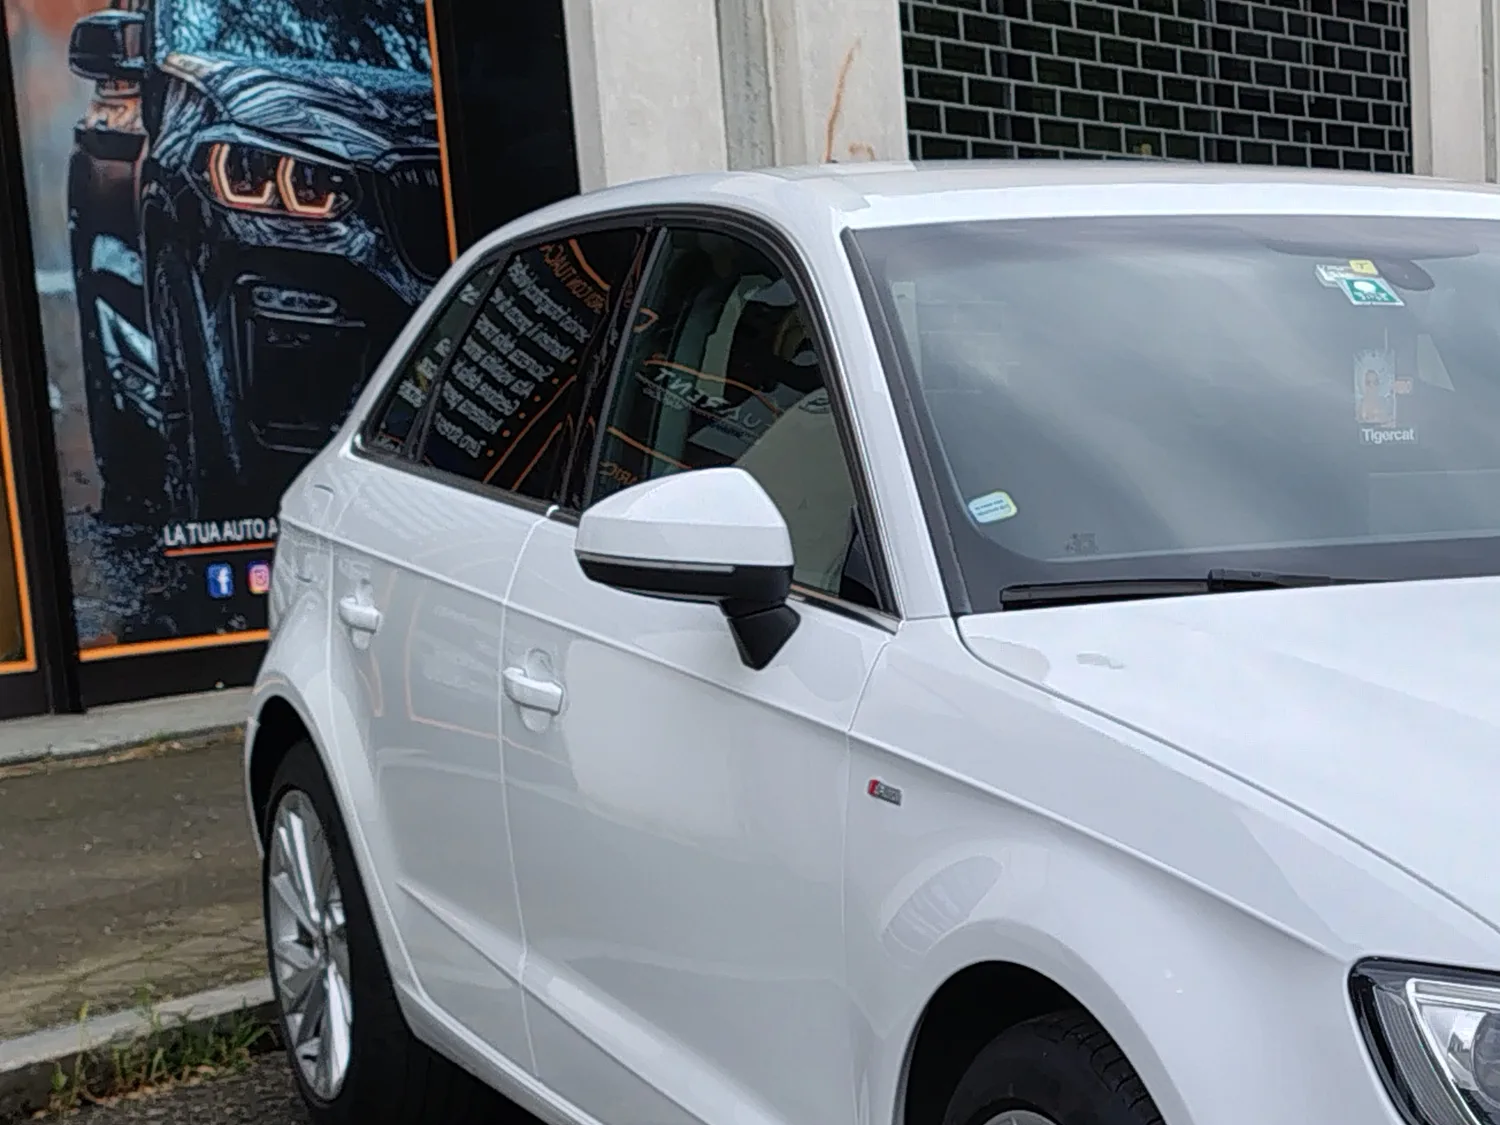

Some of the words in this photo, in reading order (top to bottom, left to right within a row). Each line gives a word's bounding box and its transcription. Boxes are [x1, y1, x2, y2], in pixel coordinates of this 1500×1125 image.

[1361, 427, 1415, 444] Tigercat
[163, 523, 187, 547] LA
[185, 521, 220, 545] TUA
[222, 518, 266, 542] AUTO
